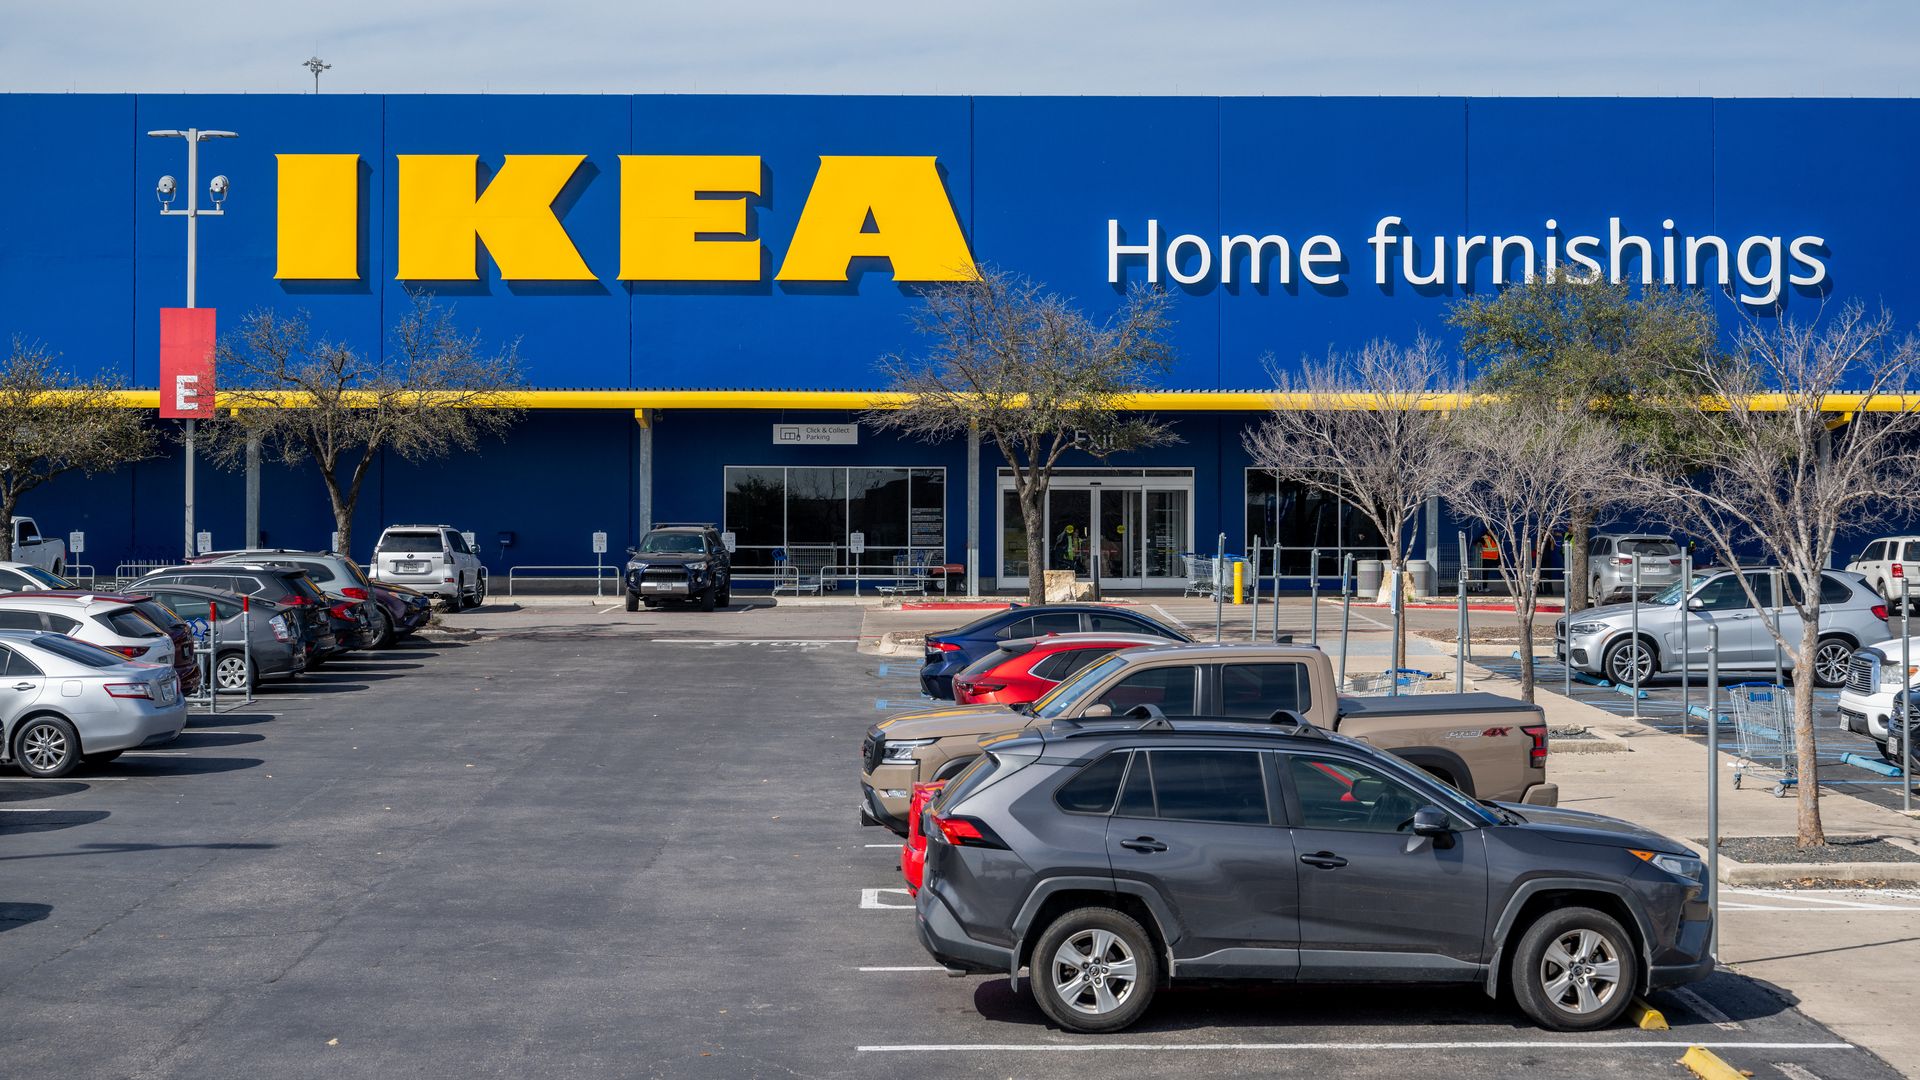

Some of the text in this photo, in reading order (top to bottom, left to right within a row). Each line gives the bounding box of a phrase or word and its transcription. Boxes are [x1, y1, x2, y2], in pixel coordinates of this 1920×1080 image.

[274, 153, 983, 282] IKEA
[1107, 216, 1827, 305] Home furnishings
[176, 374, 199, 410] E
